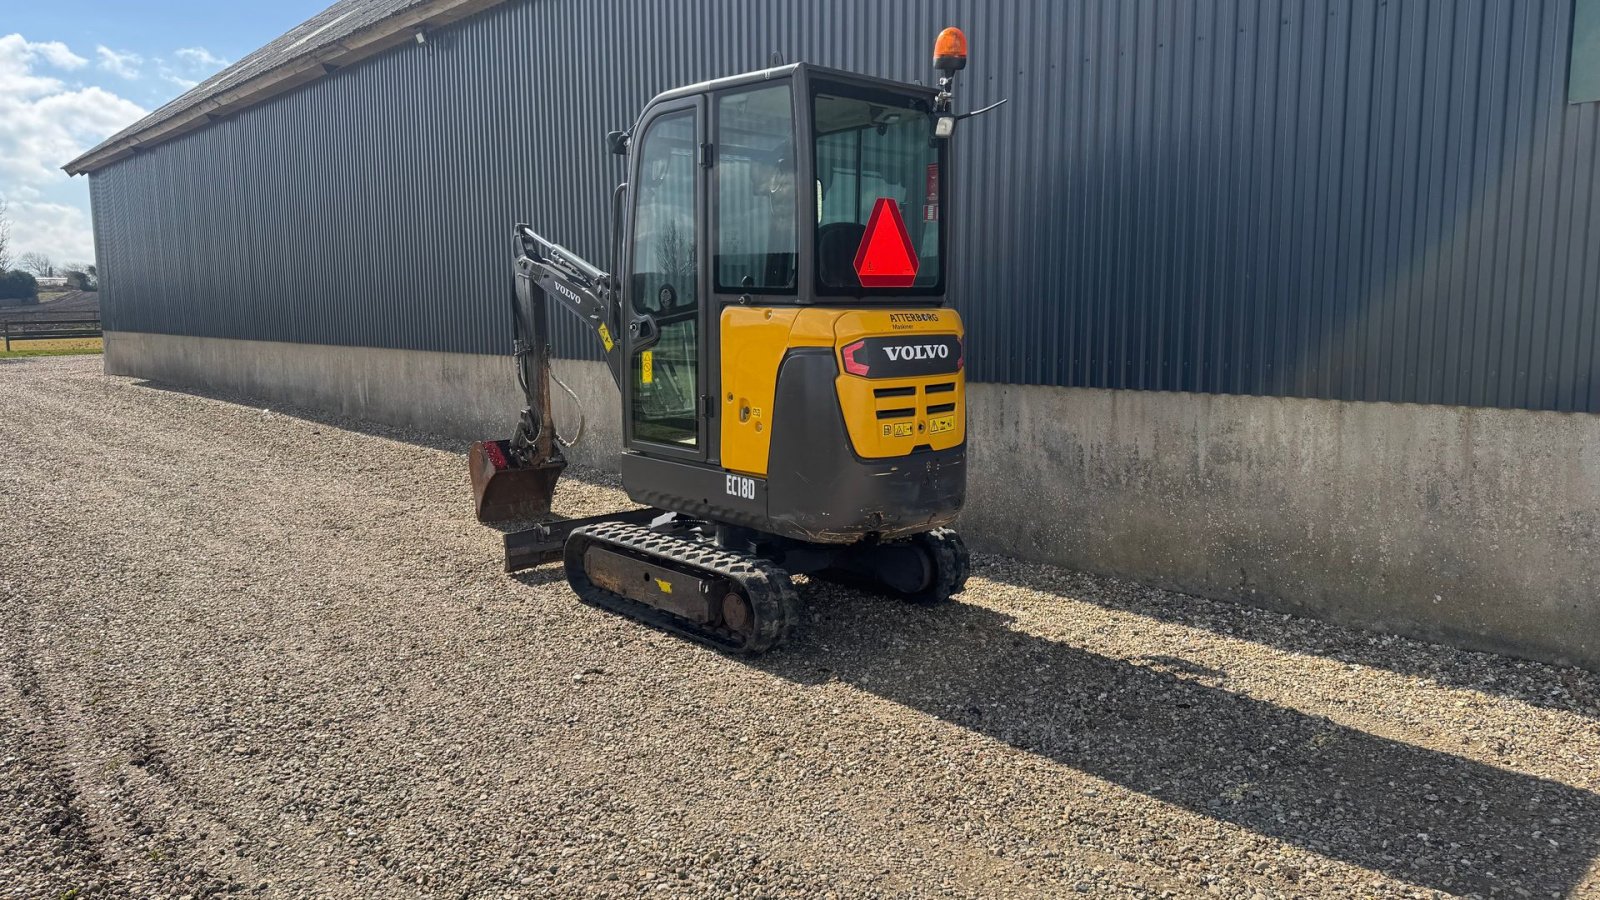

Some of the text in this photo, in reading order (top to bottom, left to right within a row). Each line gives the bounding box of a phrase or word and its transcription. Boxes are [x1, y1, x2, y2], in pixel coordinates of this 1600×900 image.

[554, 281, 581, 305] VOLVO
[889, 313, 939, 323] ATTERBORG
[883, 344, 949, 361] VOLVO
[726, 474, 755, 500] EC18D
